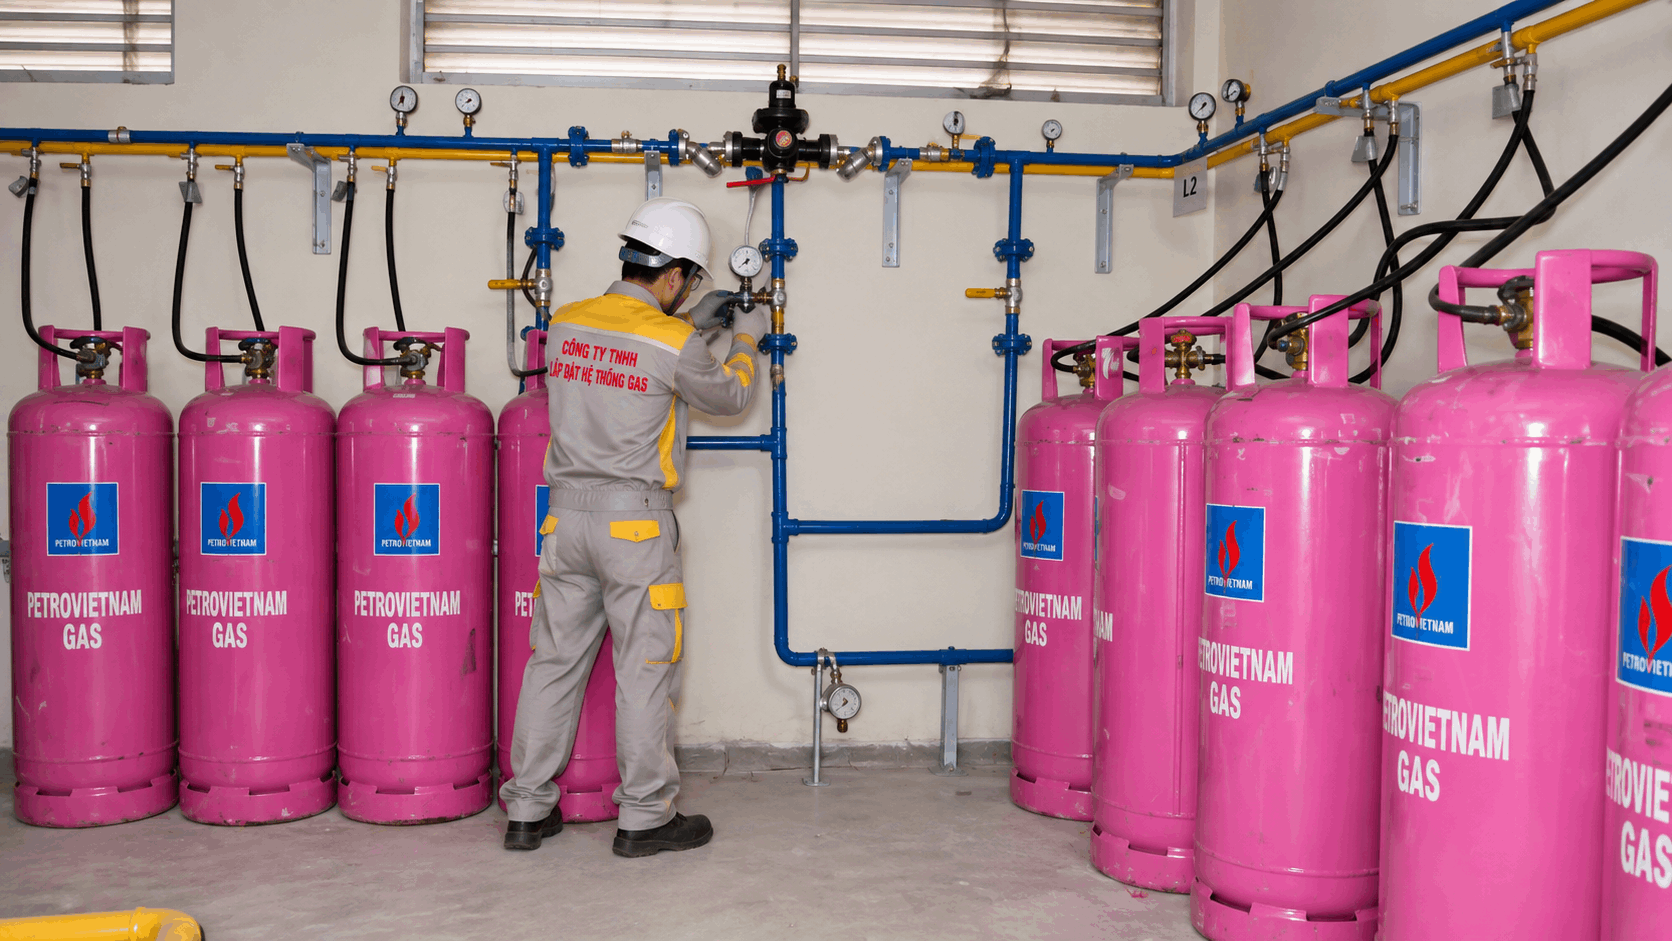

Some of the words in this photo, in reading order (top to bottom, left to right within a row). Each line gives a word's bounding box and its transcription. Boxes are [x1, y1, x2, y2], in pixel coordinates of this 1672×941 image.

[1183, 176, 1197, 198] L2
[593, 345, 607, 362] TY
[609, 348, 638, 367] TNHH
[627, 374, 649, 393] GAS
[27, 590, 142, 618] PETROVIETNAM
[186, 589, 288, 617] PETROVIETNAM
[354, 590, 461, 617] PETROVIETNAM
[515, 590, 536, 617] PET
[63, 623, 103, 650] GAS
[212, 622, 248, 648] GAS
[387, 622, 423, 648] GAS
[1024, 619, 1047, 647] GAS
[1198, 636, 1293, 685] ETROVIETNAM
[1623, 651, 1672, 678] PETROVIET
[1209, 681, 1241, 719] GAS
[1383, 690, 1510, 761] ETROVIETNAM
[1397, 750, 1441, 802] GAS
[1606, 745, 1672, 824] ETROVIE
[1621, 821, 1672, 889] GAS
